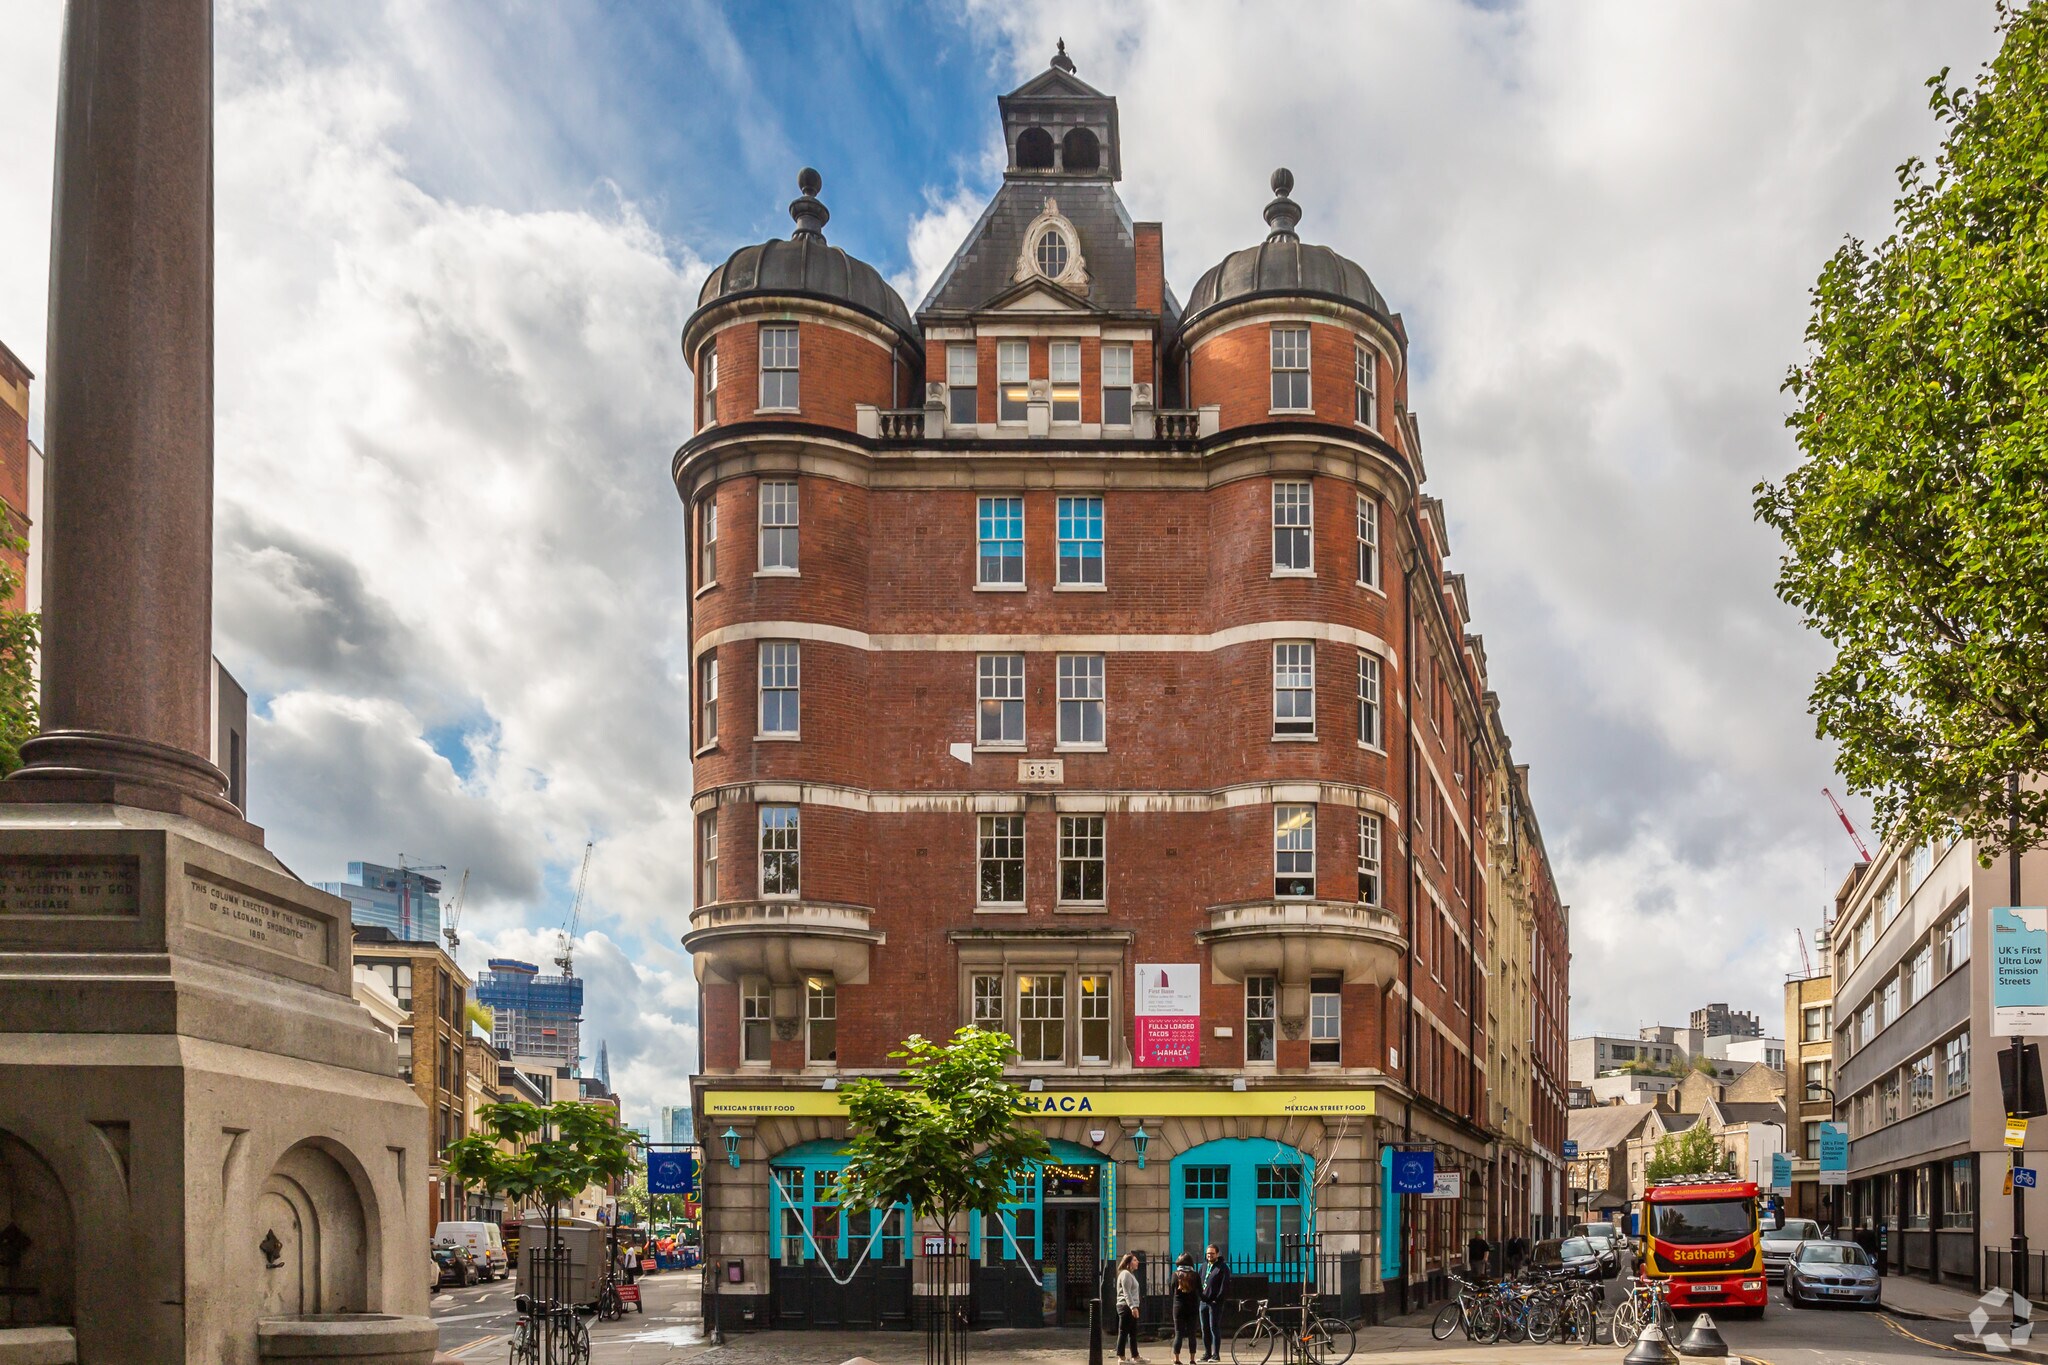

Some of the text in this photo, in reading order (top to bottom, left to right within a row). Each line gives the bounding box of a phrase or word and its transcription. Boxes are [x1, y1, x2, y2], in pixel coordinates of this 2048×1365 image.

[80, 885, 101, 895] BUT
[109, 883, 133, 894] GOD
[191, 881, 318, 931] THIS COLUMN ERECTED BY THE VESTRY
[209, 902, 218, 911] OF
[233, 910, 263, 927] LEONARD
[267, 921, 304, 940] SHOREDITCH
[1998, 946, 2042, 955] UK's First
[1998, 956, 2043, 965] Ultra Low
[1998, 967, 2039, 975] Emission
[1998, 977, 2031, 985] Streets
[655, 1180, 686, 1190] WAHACA
[1398, 1180, 1427, 1189] WAHACA
[1673, 1248, 1736, 1260] Statham's
